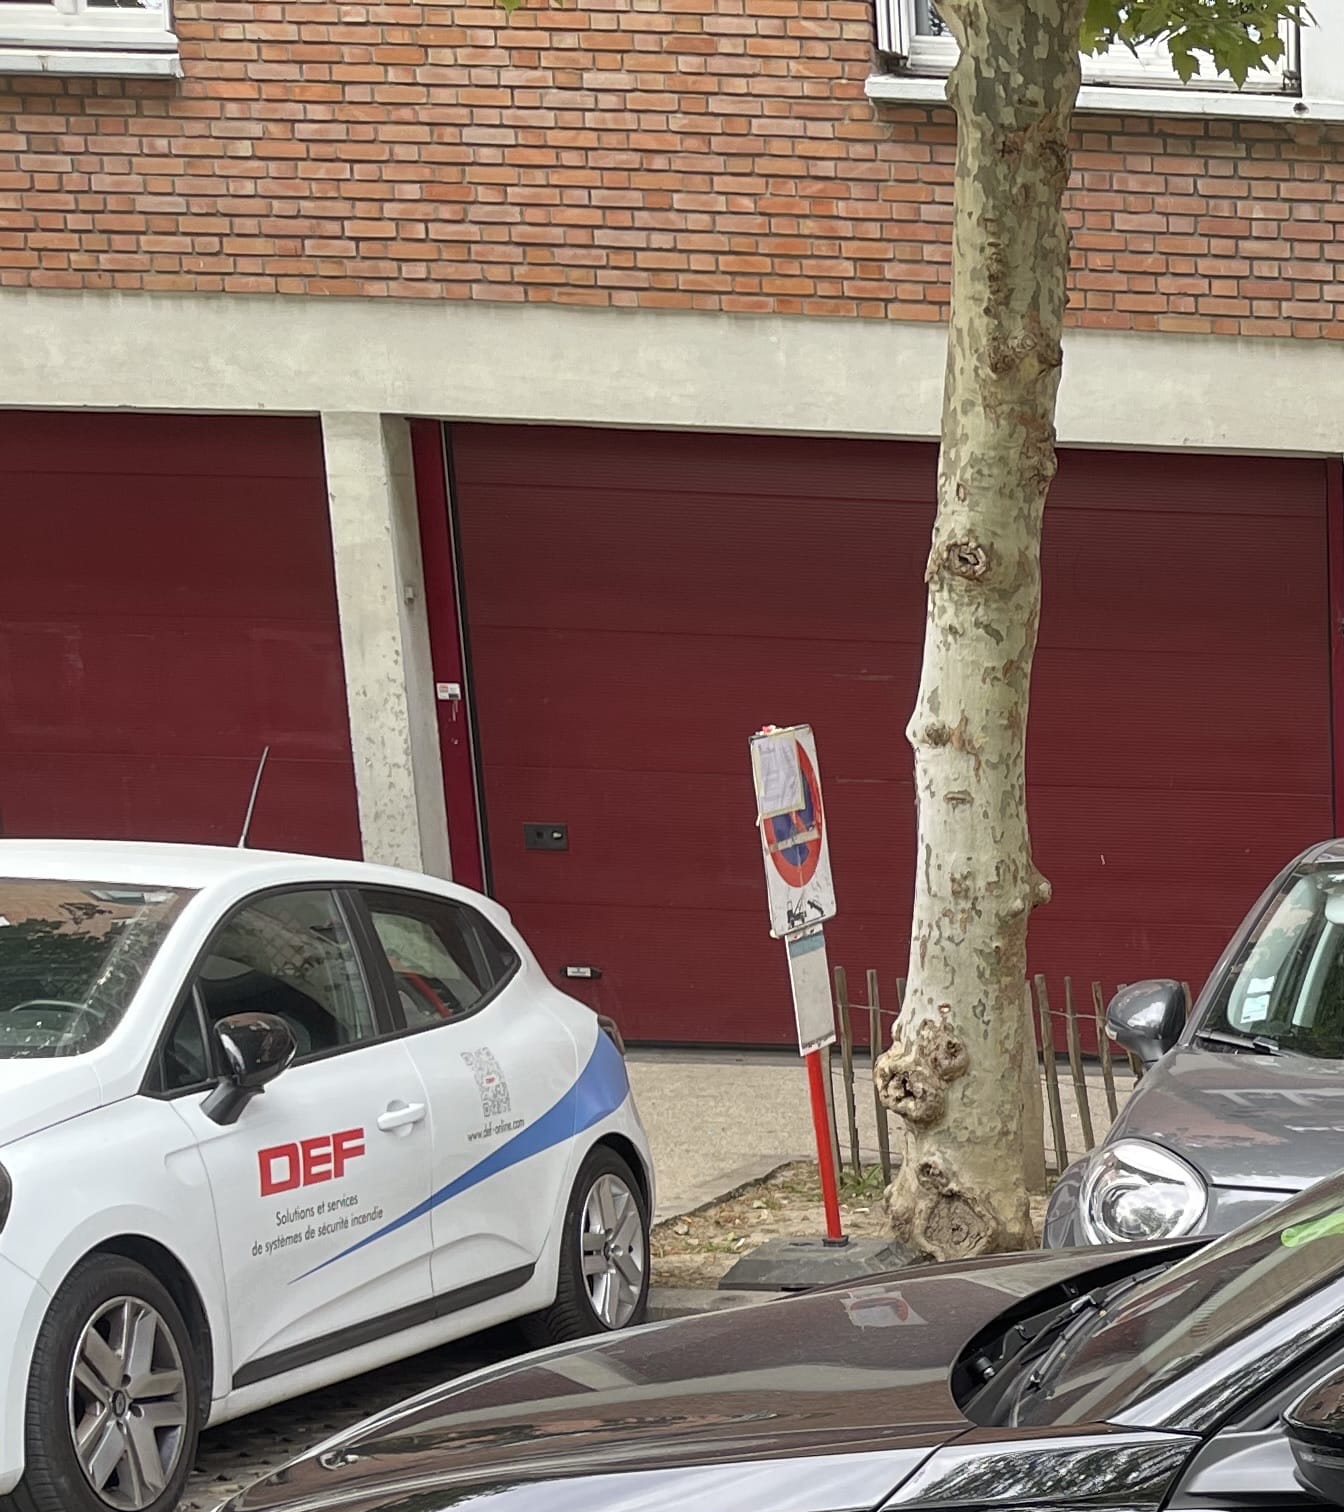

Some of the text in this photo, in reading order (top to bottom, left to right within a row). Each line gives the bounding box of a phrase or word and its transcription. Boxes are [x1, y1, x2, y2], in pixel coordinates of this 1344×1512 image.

[257, 1127, 365, 1197] DEF
[251, 1205, 384, 1256] de systèmes de sécurité incendie
[276, 1193, 359, 1226] Solutions et services
